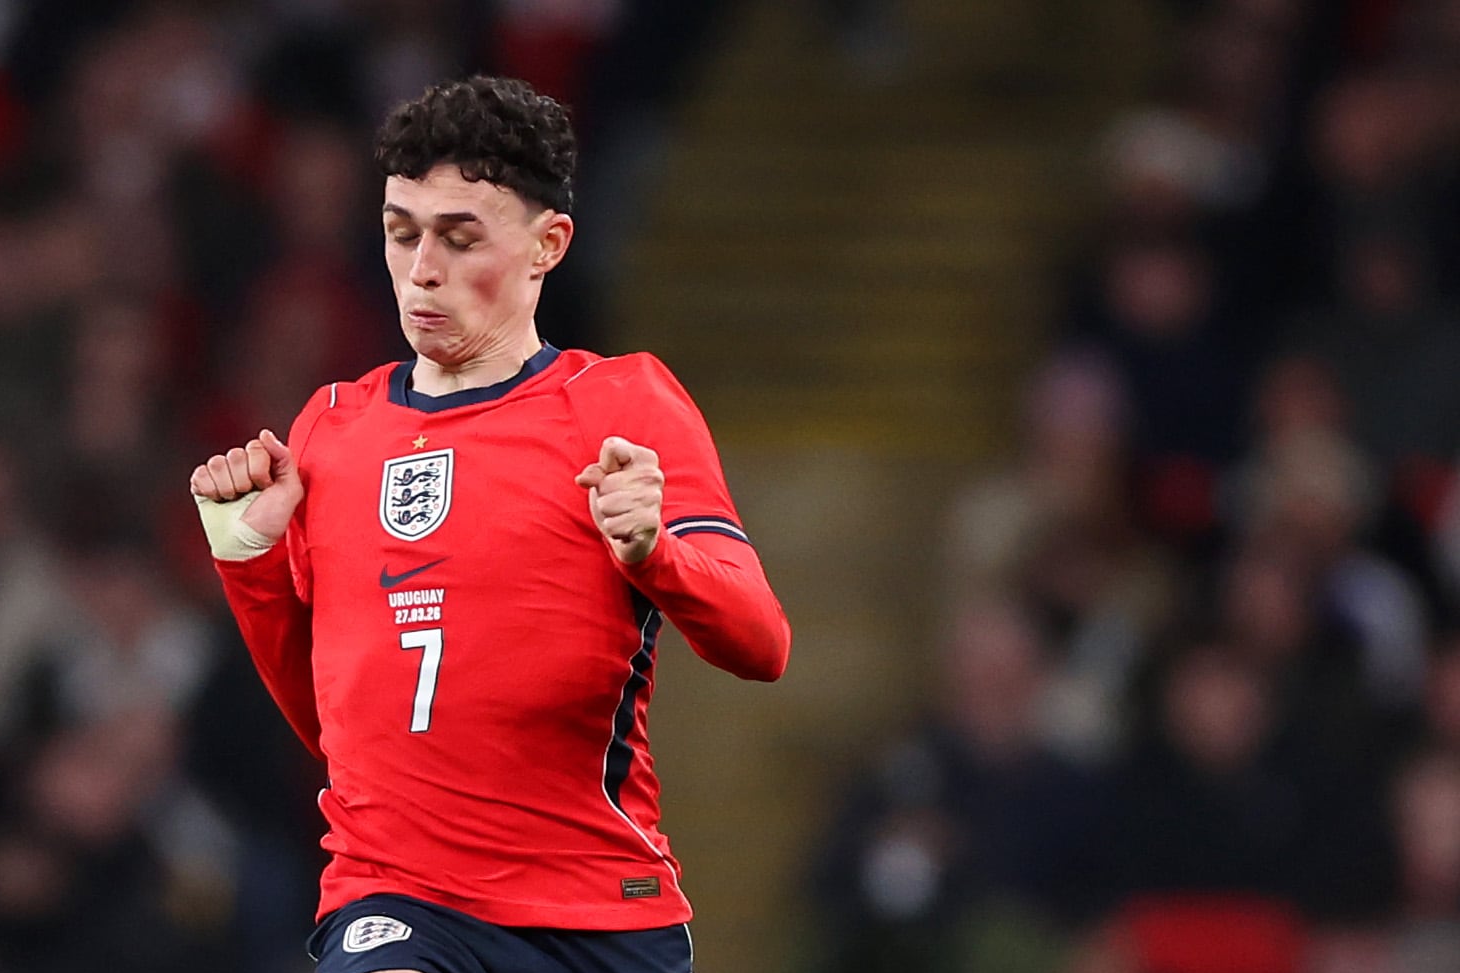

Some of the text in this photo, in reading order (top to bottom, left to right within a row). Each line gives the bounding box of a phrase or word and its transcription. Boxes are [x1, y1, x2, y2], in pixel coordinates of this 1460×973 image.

[388, 589, 445, 608] URUGUAY
[395, 606, 441, 624] 27.03.26
[400, 627, 444, 733] 7
